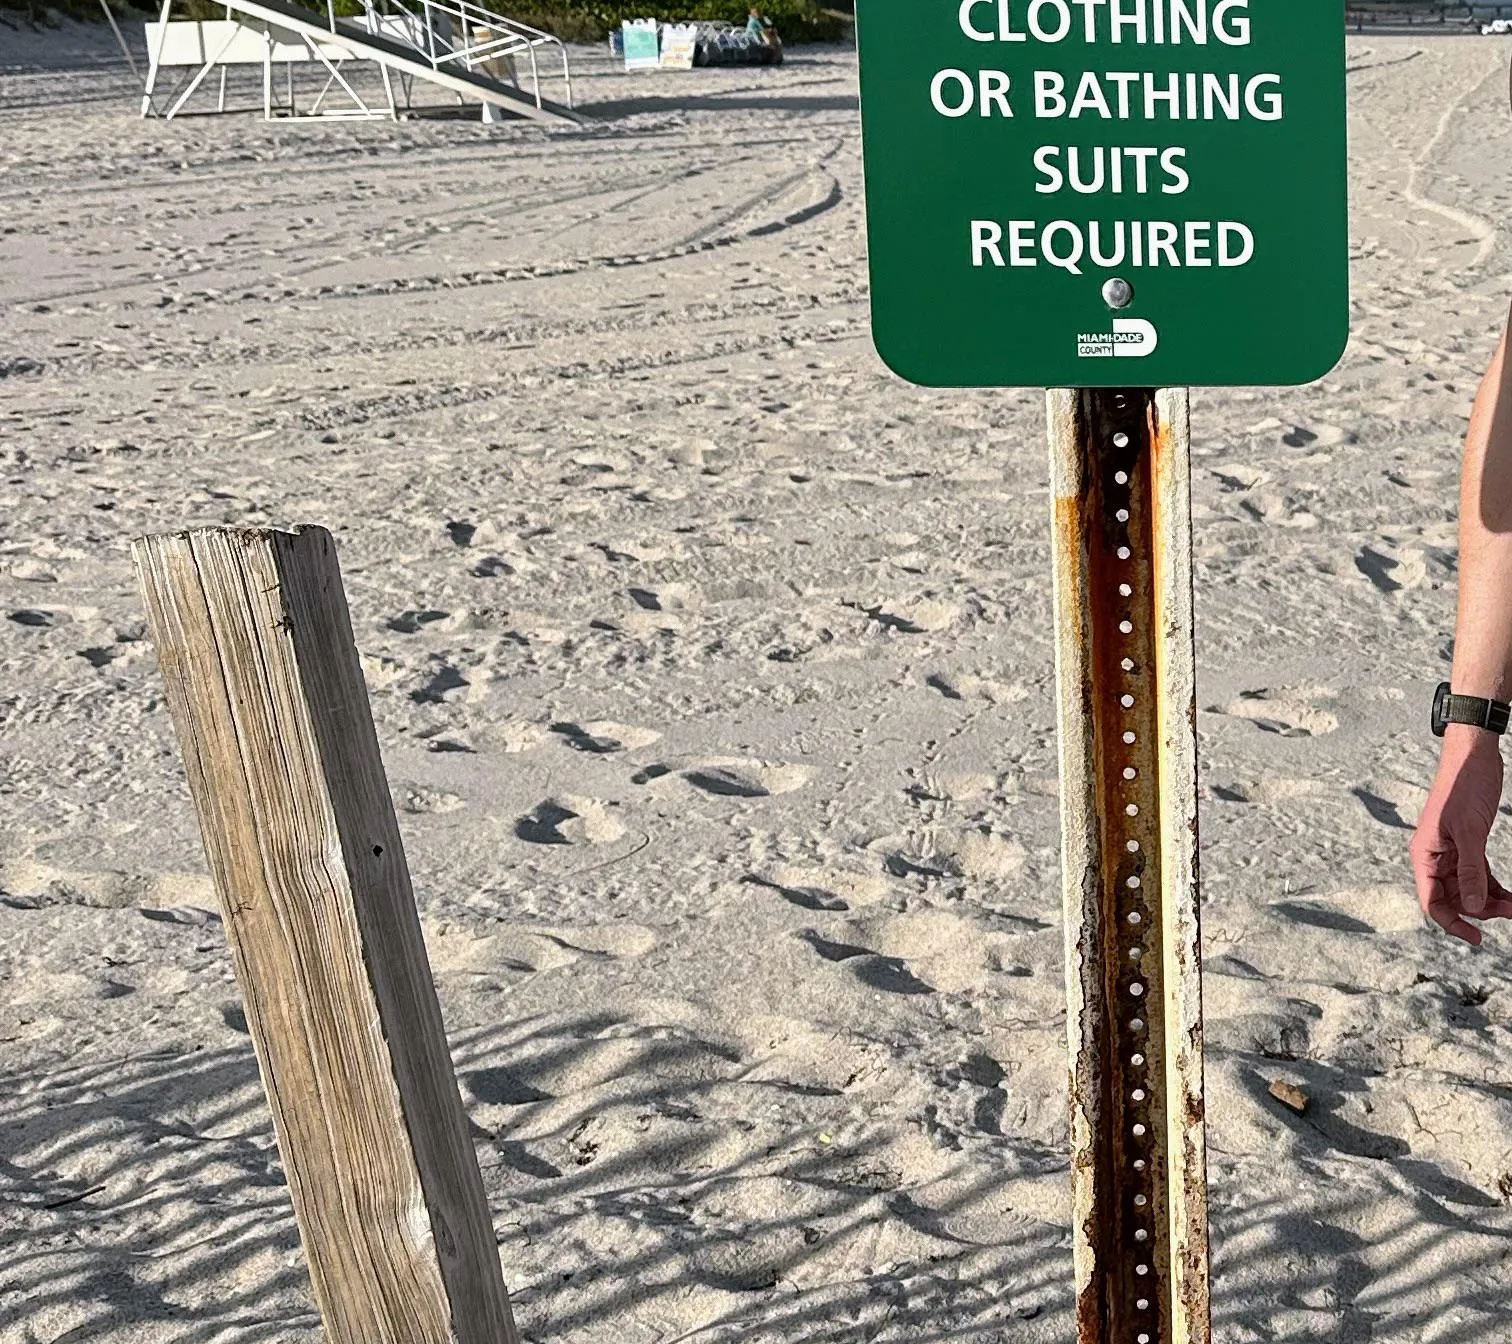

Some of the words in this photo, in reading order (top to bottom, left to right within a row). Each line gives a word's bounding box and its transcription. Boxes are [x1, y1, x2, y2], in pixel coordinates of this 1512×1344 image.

[931, 69, 1013, 117] OR
[1034, 71, 1282, 120] BATHING
[1034, 146, 1188, 194] SUITS
[971, 220, 1253, 274] REQUIRED
[1079, 345, 1112, 355] COUNTY
